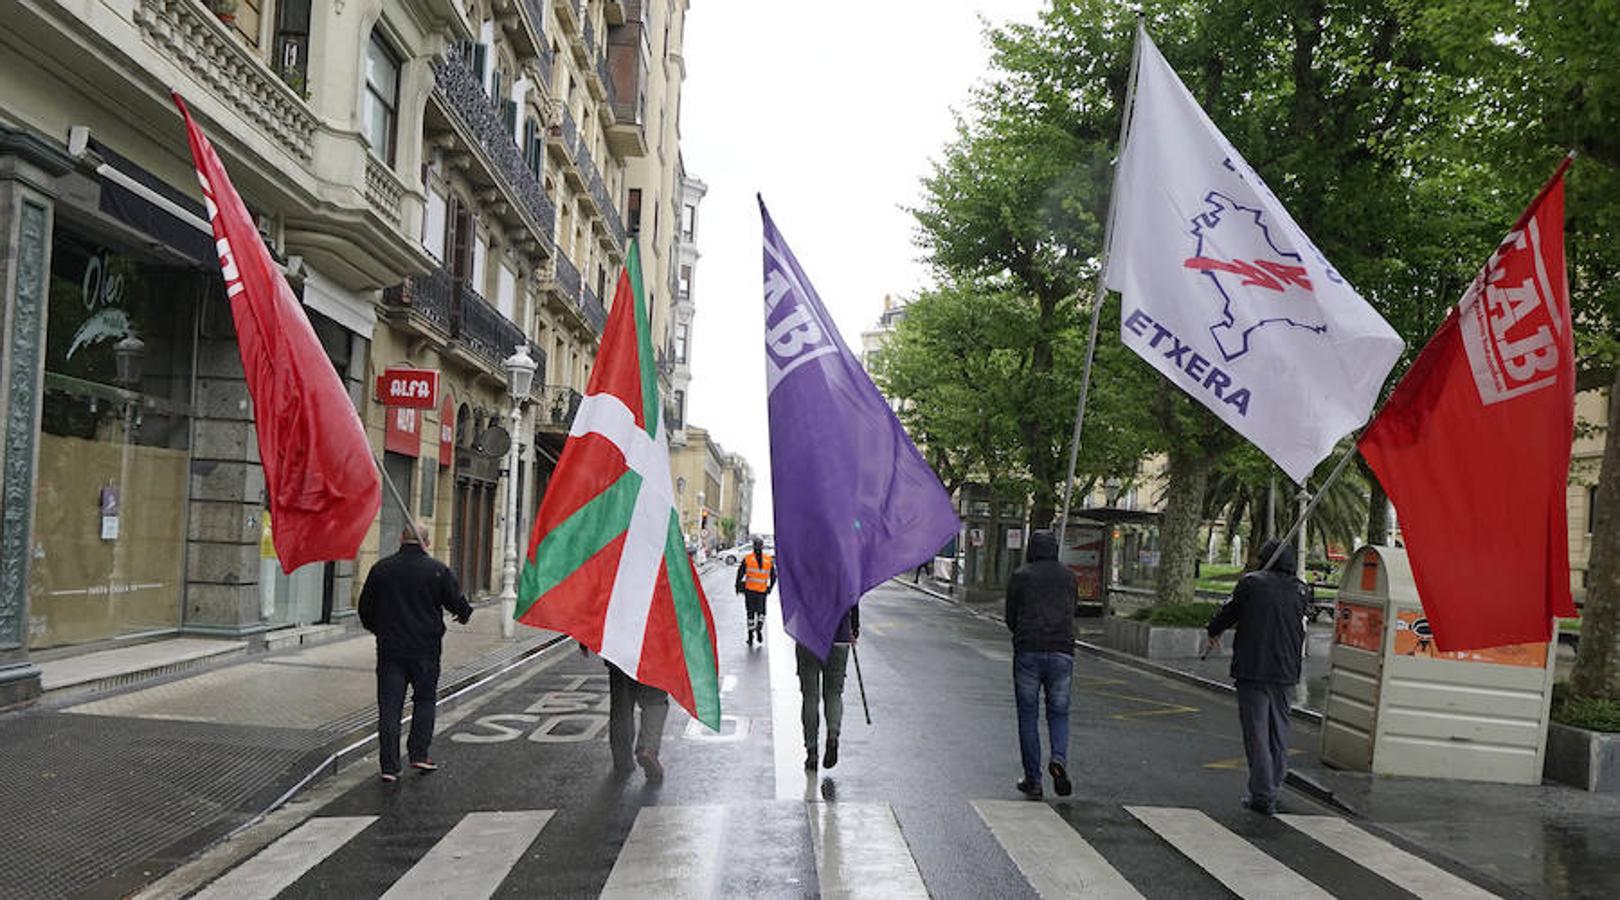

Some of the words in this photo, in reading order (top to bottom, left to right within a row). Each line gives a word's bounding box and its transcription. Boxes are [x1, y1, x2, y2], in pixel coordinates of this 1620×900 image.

[83, 252, 125, 312] Oleo
[764, 268, 823, 358] AB
[390, 379, 431, 399] ALFA
[1124, 309, 1252, 417] ETXERA
